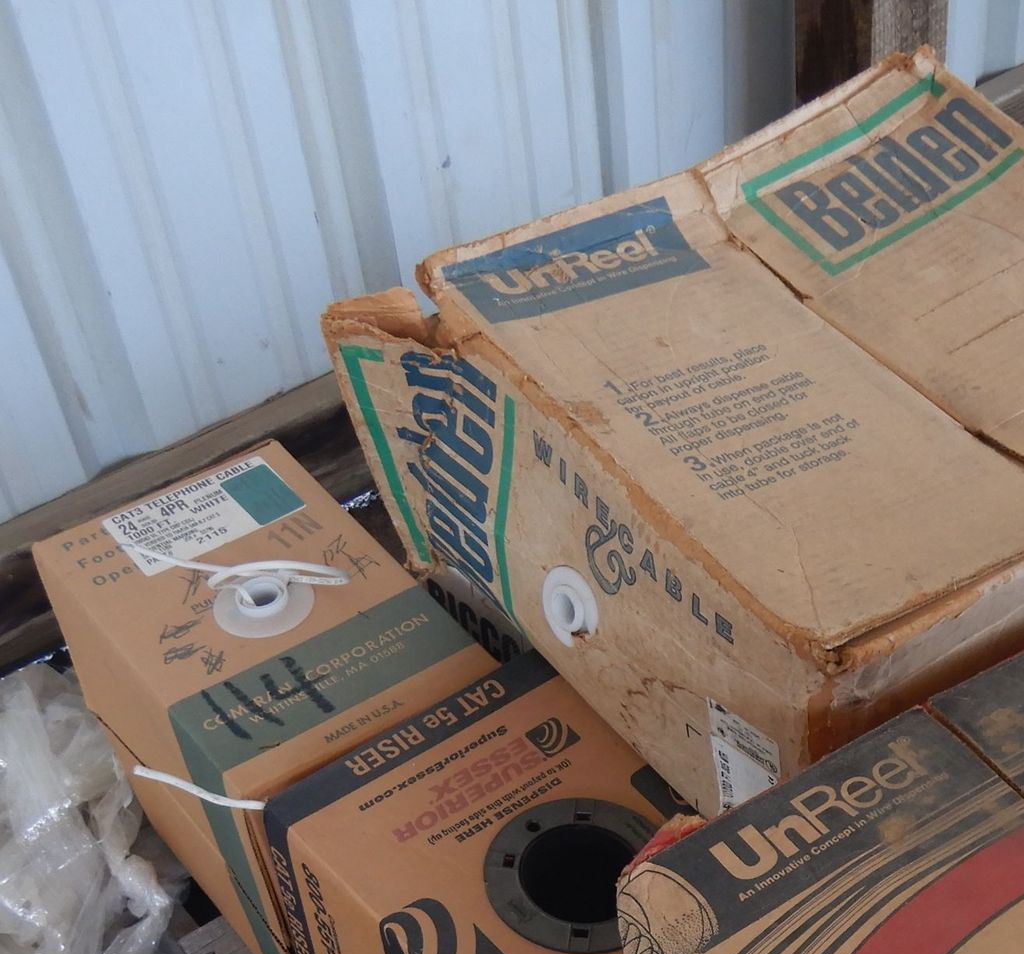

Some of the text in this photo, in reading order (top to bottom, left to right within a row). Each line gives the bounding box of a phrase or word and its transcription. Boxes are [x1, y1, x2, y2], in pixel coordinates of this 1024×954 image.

[777, 97, 1012, 251] Belden
[481, 229, 659, 296] UnReel
[607, 268, 628, 280] Wire
[631, 376, 652, 391] For
[658, 368, 684, 384] best
[734, 343, 767, 361] place
[664, 400, 711, 423] Always
[712, 381, 769, 408] dispense
[770, 370, 804, 386] cable
[712, 446, 751, 468] When
[752, 425, 807, 453] package
[822, 412, 844, 426] not
[111, 507, 144, 525] CAT3
[145, 477, 216, 510] TELEPHONE
[215, 461, 253, 482] CABLE
[118, 520, 138, 536] 24
[160, 499, 189, 518] 4PR
[128, 525, 155, 541] 1000
[189, 495, 229, 514] WHITE
[196, 527, 228, 544] 2115
[533, 430, 610, 531] WIRE
[618, 523, 734, 645] CABLE
[304, 613, 429, 682] CORPORATION
[346, 660, 369, 676] MA
[324, 724, 357, 744] MADE
[358, 717, 370, 727] IN
[345, 679, 506, 776] CAT 5e RISER
[358, 725, 509, 812] SuperiorEssex.com
[392, 753, 542, 844] SUPERIOR
[428, 736, 530, 799] ESSEX
[455, 777, 562, 843] DISPENSE HERE
[709, 741, 927, 880] UnReel
[271, 846, 294, 892] CAT
[738, 890, 755, 902] An
[756, 855, 811, 892] Innovative
[810, 825, 856, 855] Concept
[854, 818, 867, 831] in
[867, 803, 893, 822] Wire
